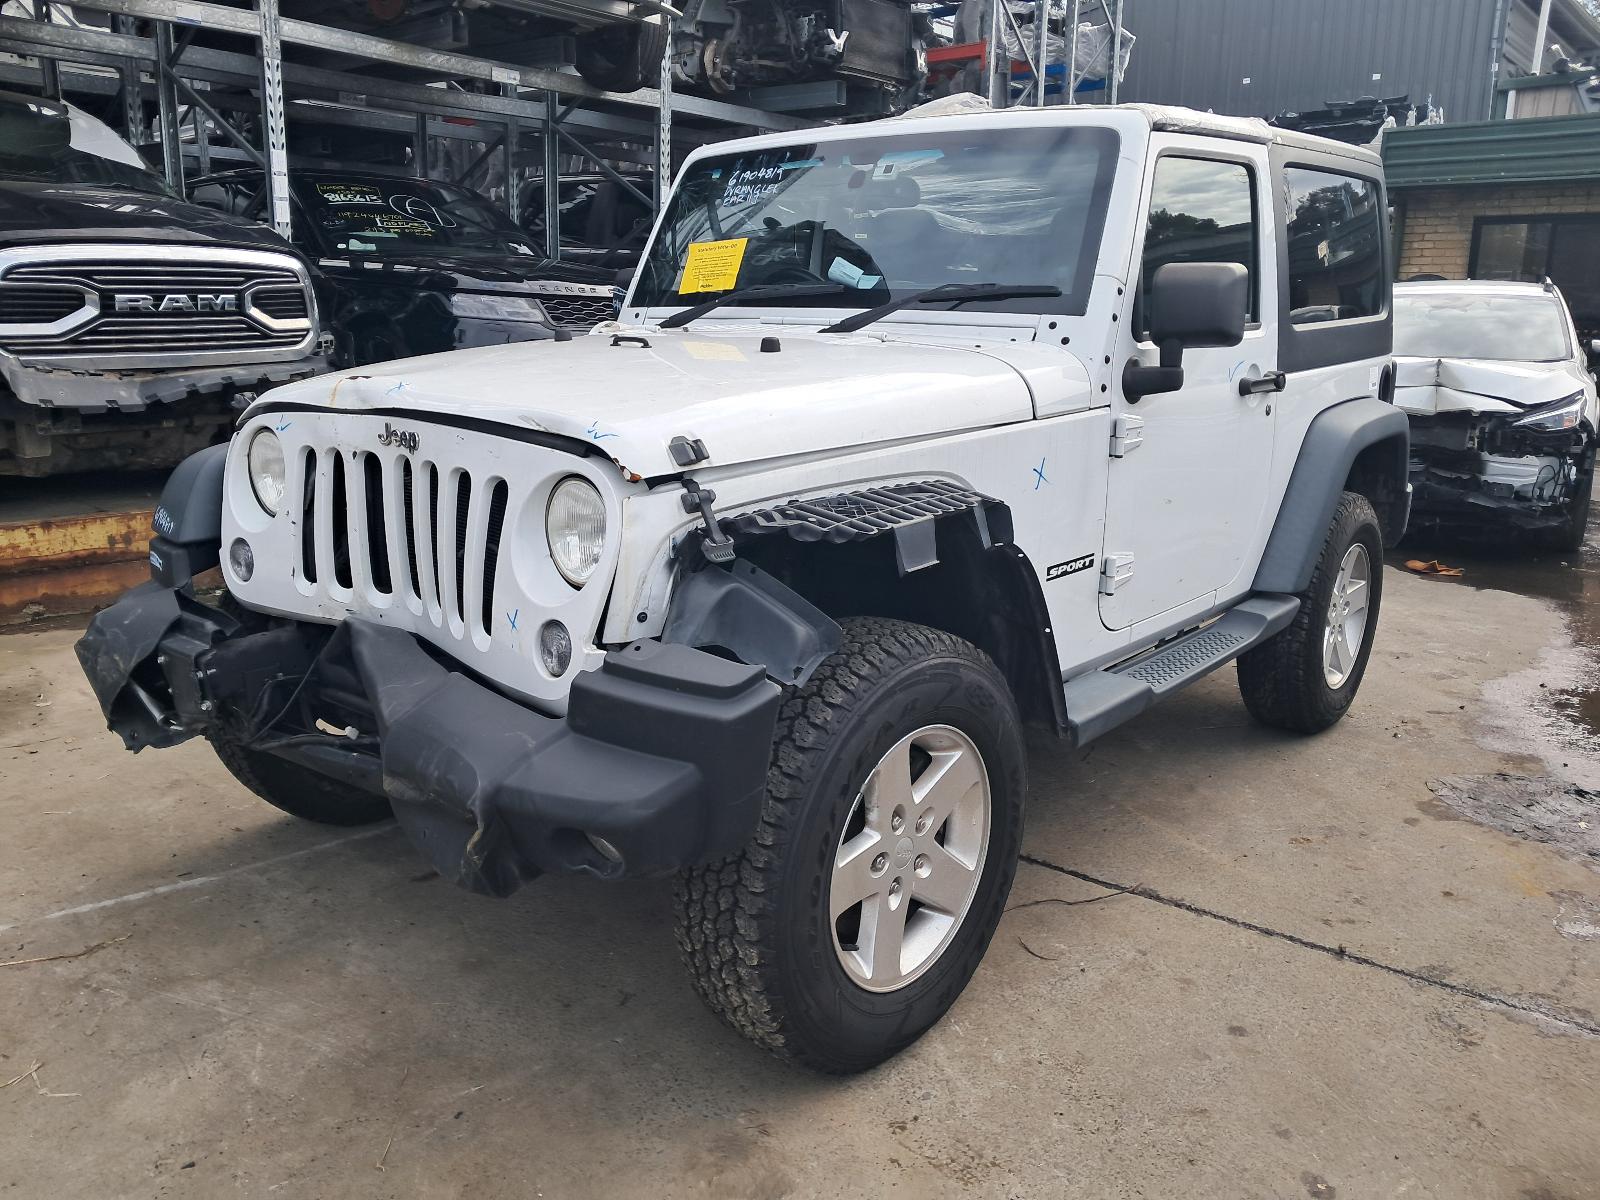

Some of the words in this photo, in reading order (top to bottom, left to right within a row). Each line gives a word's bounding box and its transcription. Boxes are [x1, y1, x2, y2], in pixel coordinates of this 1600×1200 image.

[728, 167, 785, 186] 61904819
[539, 285, 597, 293] RANGE
[114, 294, 237, 312] RAM
[377, 422, 420, 456] Jeep
[1048, 557, 1093, 578] SPORT
